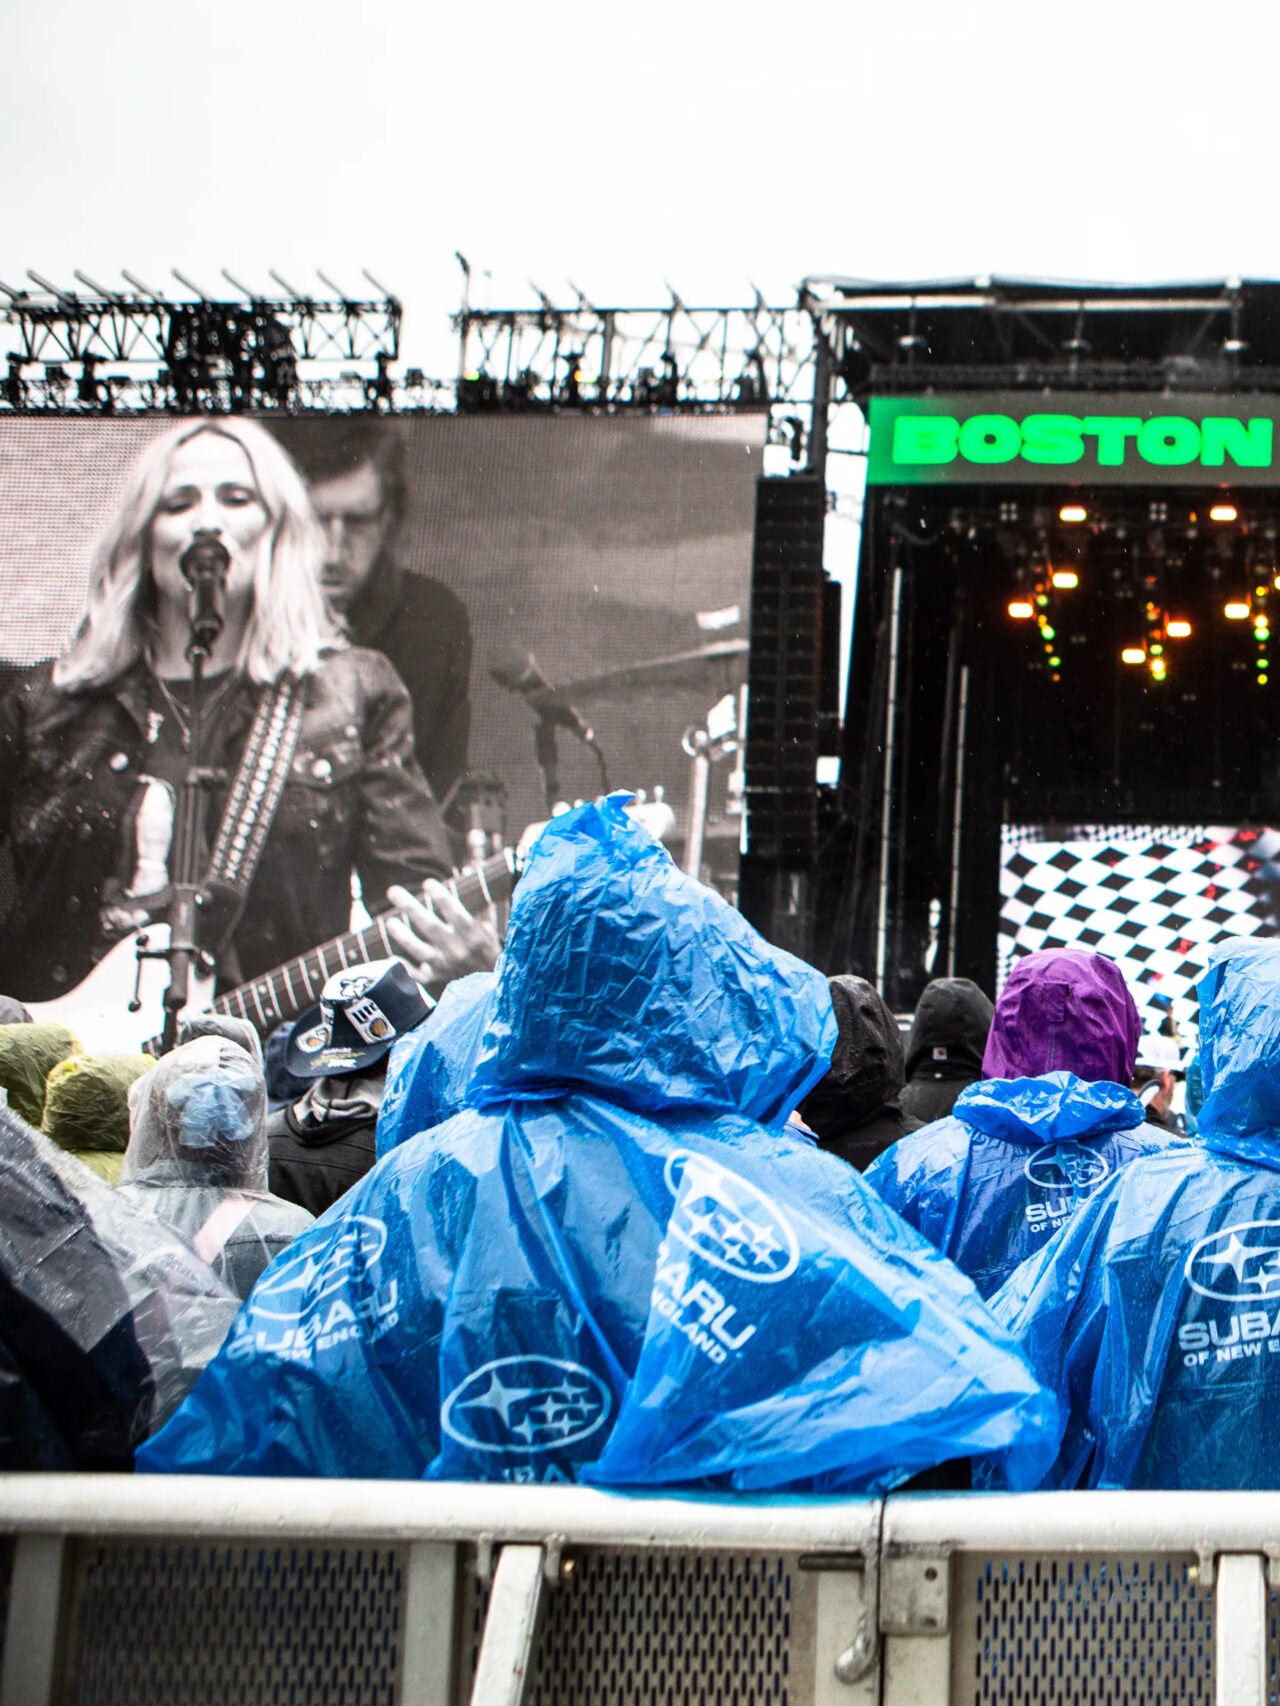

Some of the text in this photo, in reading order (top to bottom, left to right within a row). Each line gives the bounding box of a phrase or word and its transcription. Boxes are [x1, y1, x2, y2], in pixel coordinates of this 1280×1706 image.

[892, 414, 1274, 467] BOSTON
[1030, 1222, 1048, 1233] OF
[1183, 1351, 1210, 1367] OF
[1216, 1341, 1262, 1363] NEW
